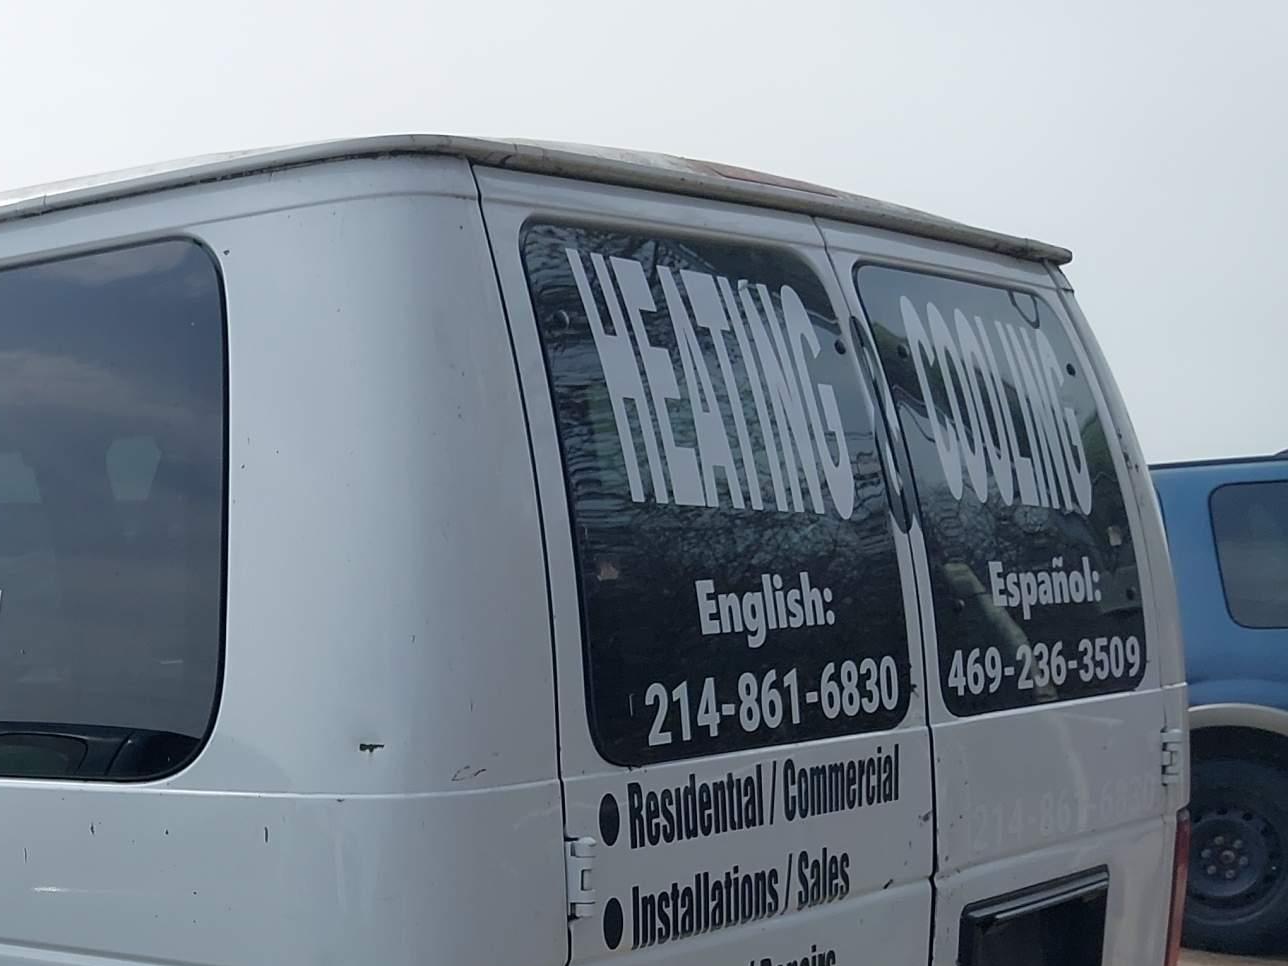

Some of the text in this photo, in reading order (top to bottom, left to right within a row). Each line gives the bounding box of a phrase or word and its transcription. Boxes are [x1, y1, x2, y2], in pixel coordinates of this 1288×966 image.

[565, 247, 854, 520] HEATING
[900, 295, 1092, 516] COOLING
[695, 571, 836, 648] English:
[988, 556, 1103, 619] Español:
[644, 655, 899, 746] 214-861-6830
[947, 635, 1141, 697] 469-236-3509
[627, 763, 763, 849] Residential
[782, 743, 899, 822] Commercial
[630, 864, 779, 950] Installations
[797, 847, 850, 911] Sales
